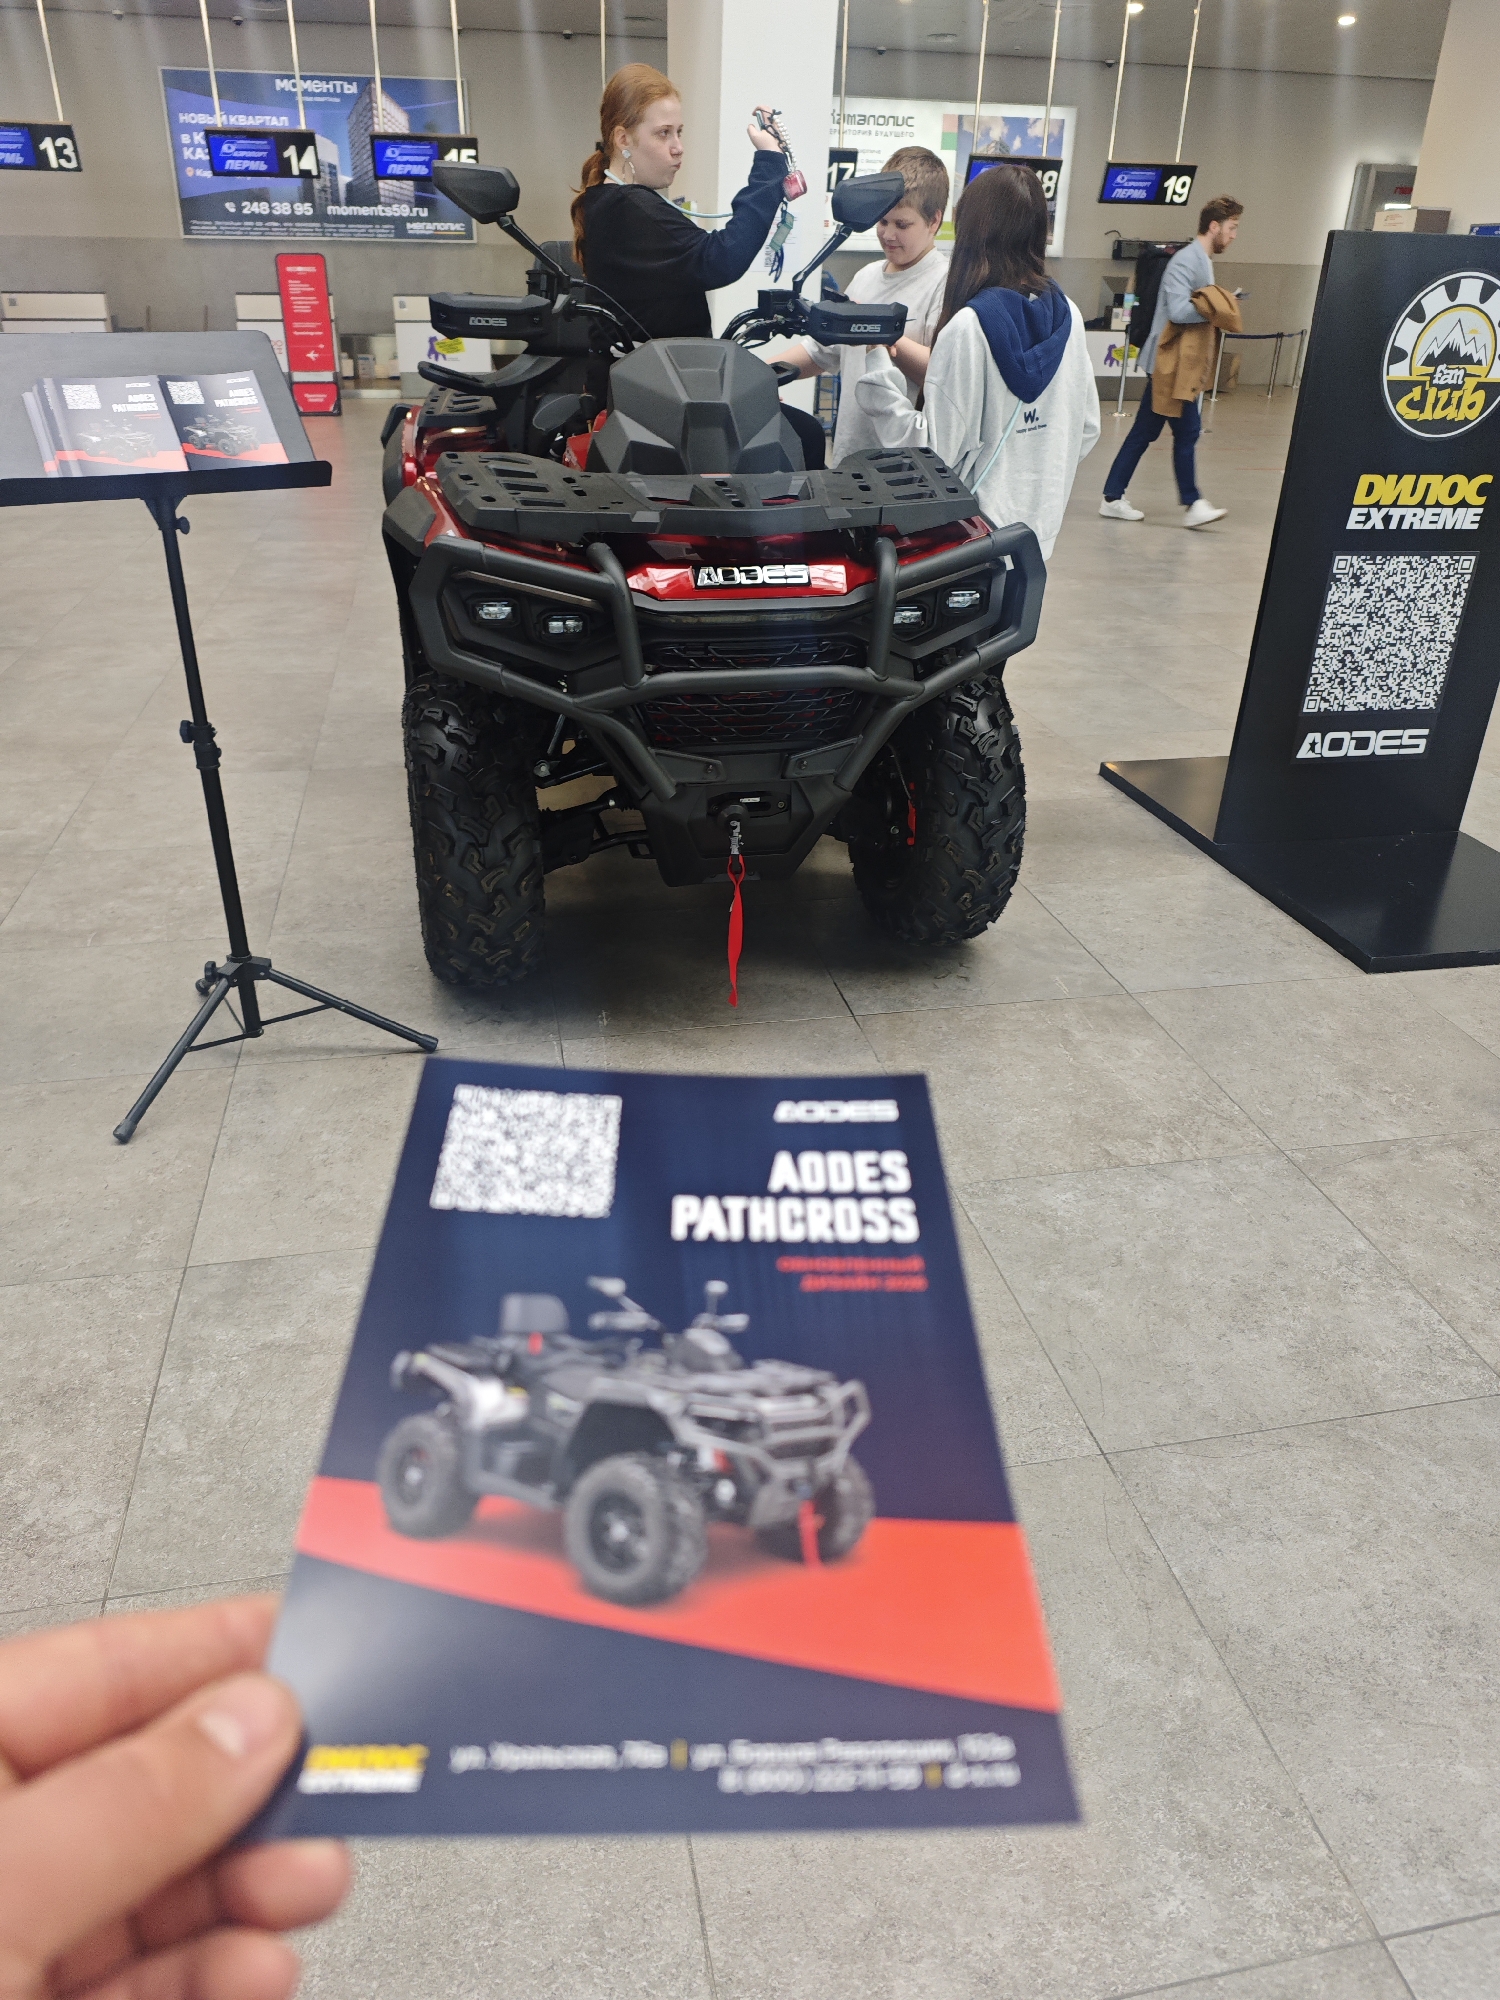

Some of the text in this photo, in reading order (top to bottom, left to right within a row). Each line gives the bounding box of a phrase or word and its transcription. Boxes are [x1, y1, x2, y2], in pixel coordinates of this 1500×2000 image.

[228, 115, 290, 126] КВАРТАЛ
[39, 136, 79, 169] 13
[283, 144, 318, 176] 14
[225, 159, 268, 171] ПЕРМЬ
[387, 163, 430, 175] ПЕРМЬ
[1111, 188, 1148, 199] ПЕРМЬ
[1163, 175, 1192, 204] 19
[241, 201, 314, 216] 248 38 95
[327, 204, 429, 217] moments59.ru
[468, 316, 508, 327] AODES
[850, 323, 882, 333] AODES
[1432, 363, 1465, 385] fan
[1345, 507, 1484, 530] EXTREME
[696, 564, 809, 587] AODES
[1296, 728, 1430, 759] AODES
[767, 1149, 912, 1194] AODES
[670, 1194, 920, 1243] PATHCROSS
